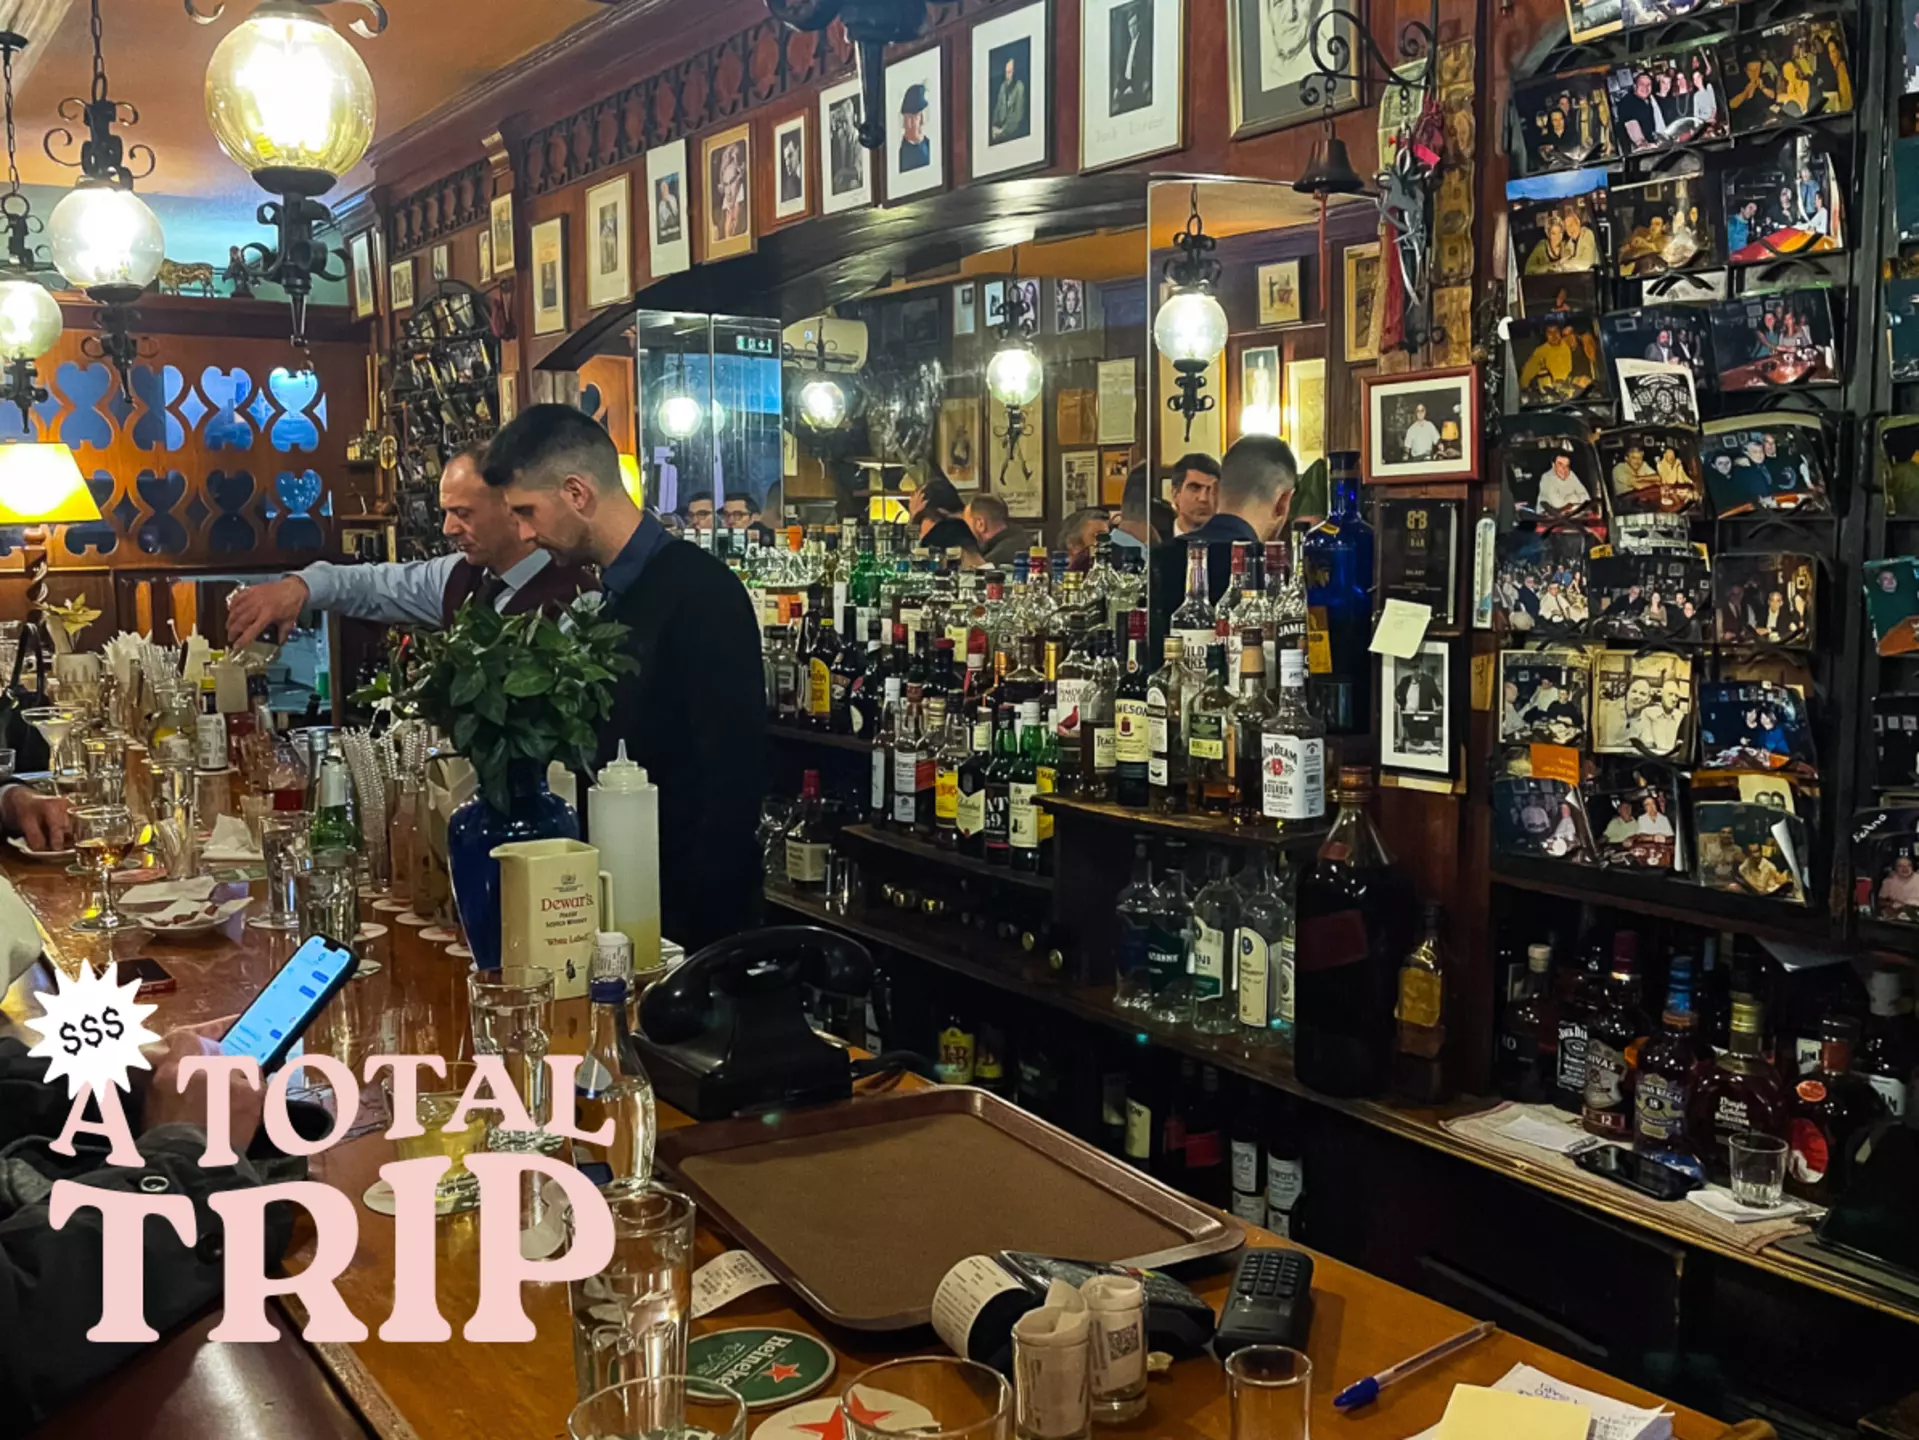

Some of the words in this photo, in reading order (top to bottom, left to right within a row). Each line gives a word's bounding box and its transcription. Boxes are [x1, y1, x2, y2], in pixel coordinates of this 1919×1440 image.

[1274, 742, 1297, 766] BEAM
[541, 893, 595, 912] Dewar's
[1602, 1114, 1613, 1126] 12
[715, 1335, 794, 1386] Heineke
